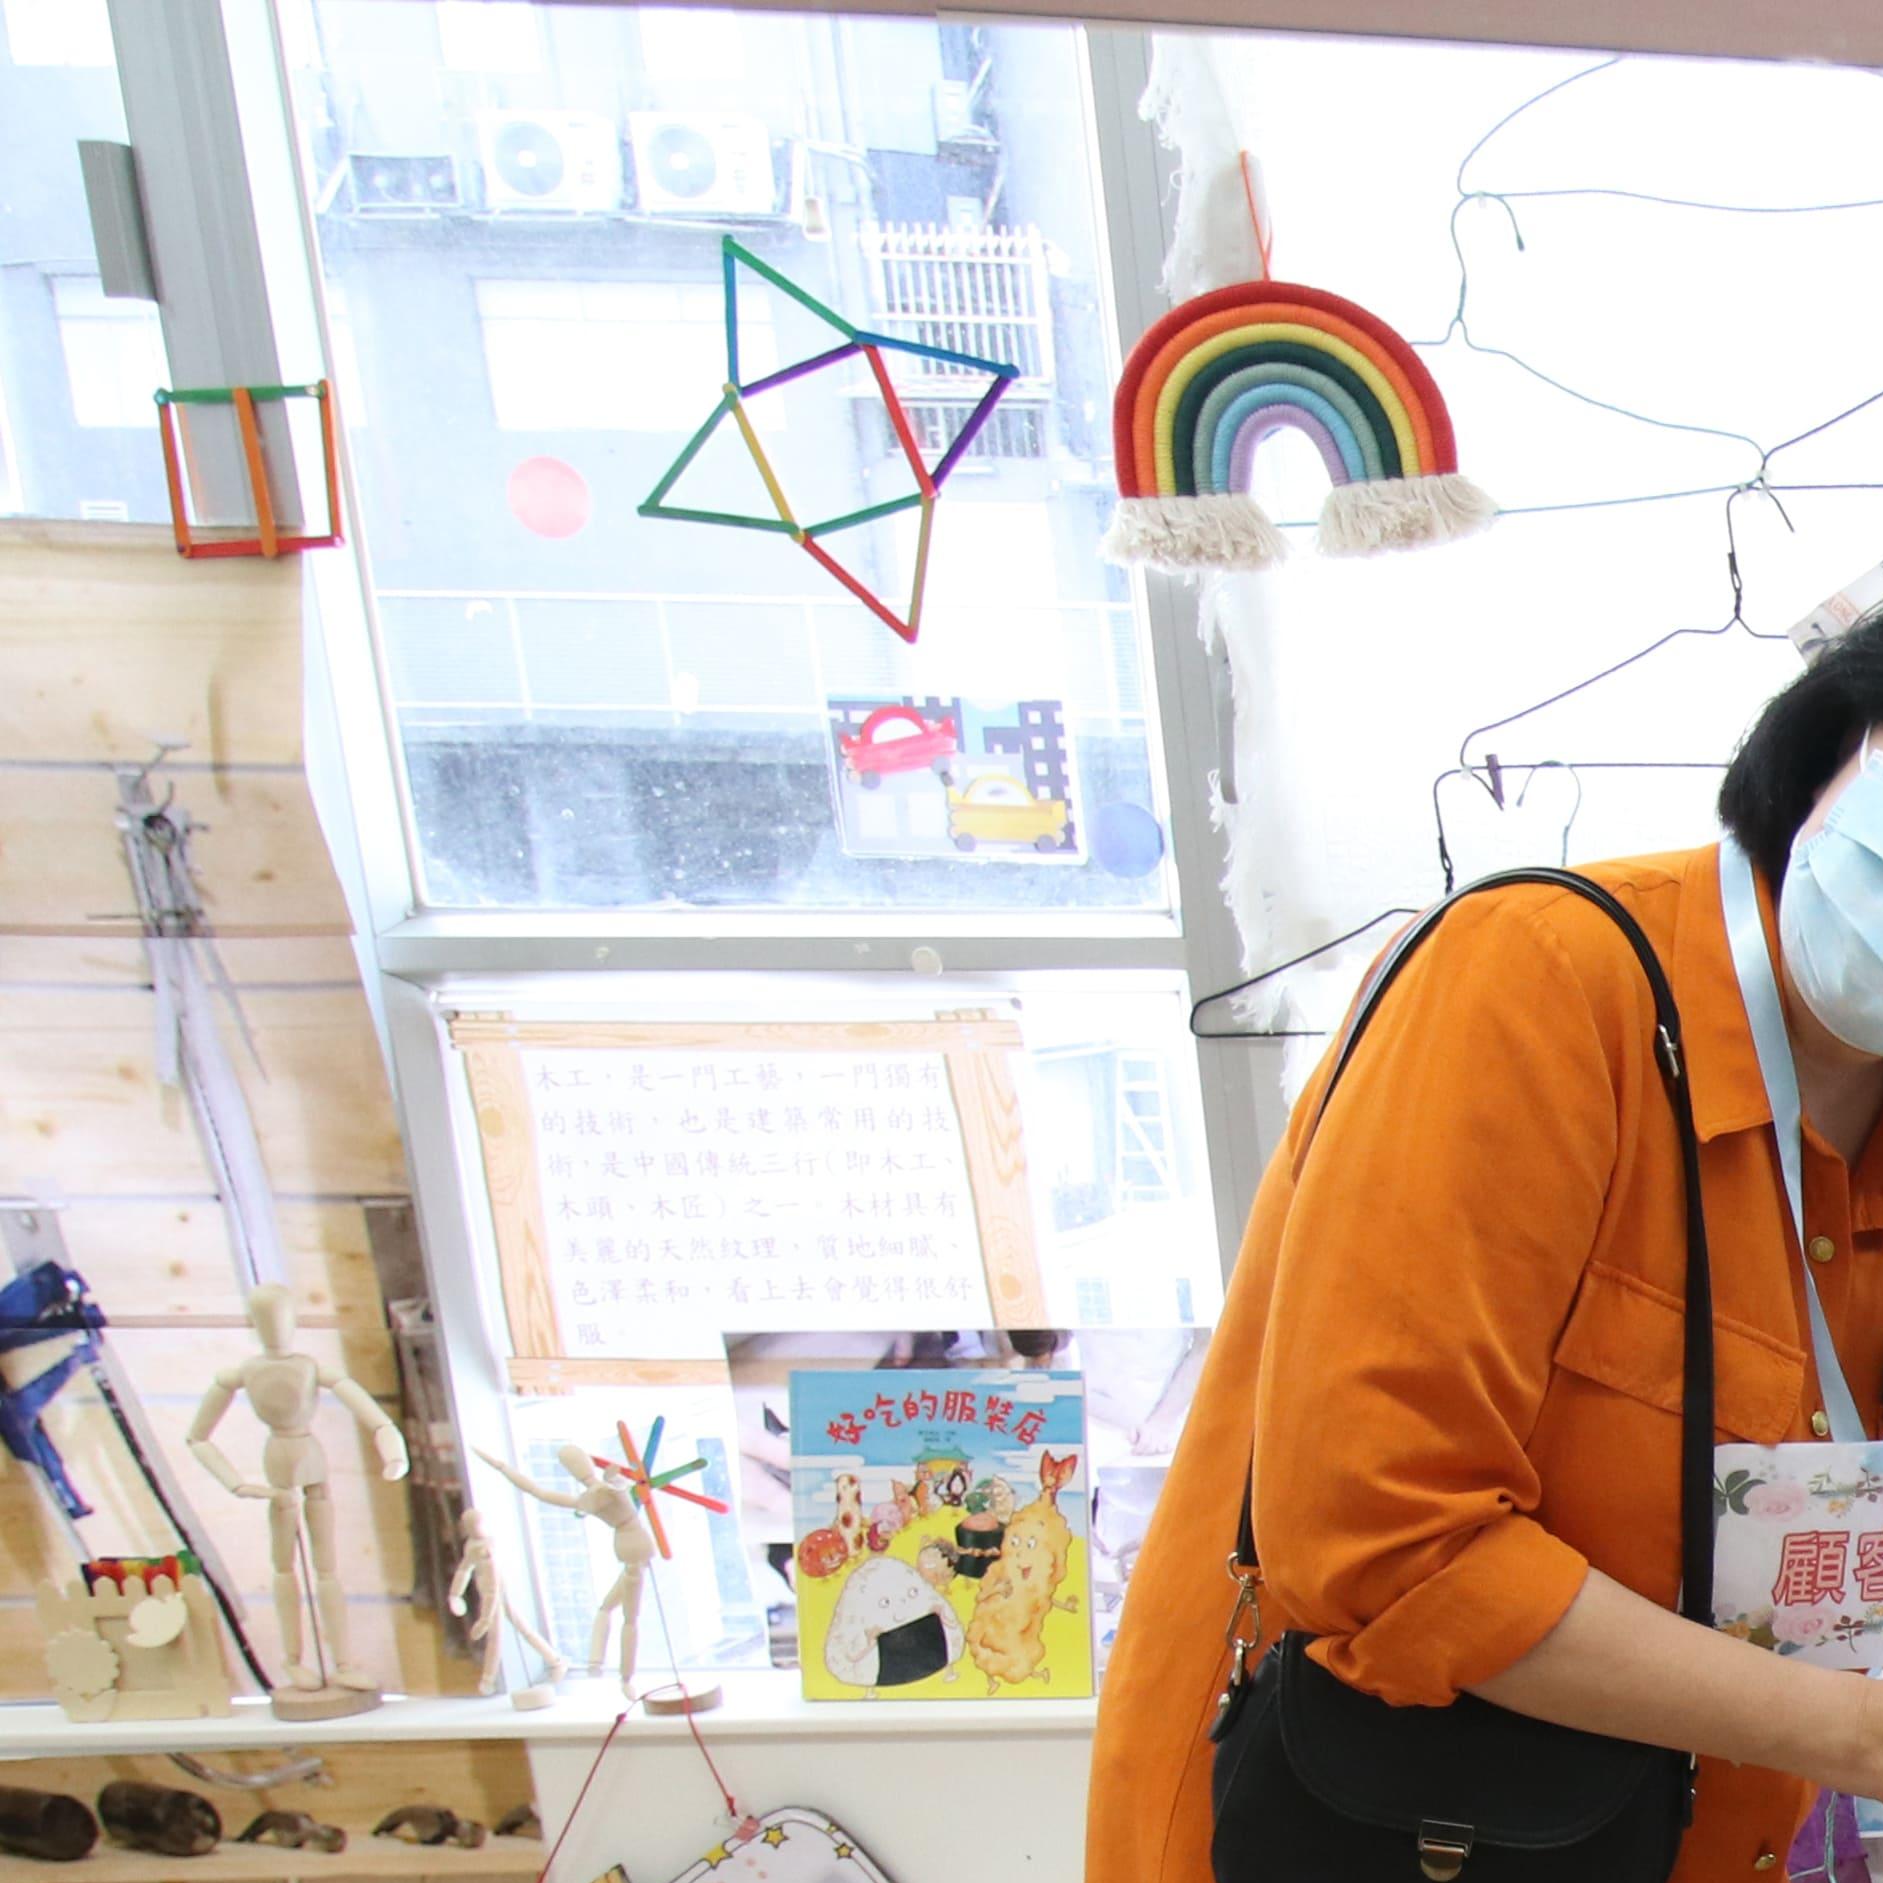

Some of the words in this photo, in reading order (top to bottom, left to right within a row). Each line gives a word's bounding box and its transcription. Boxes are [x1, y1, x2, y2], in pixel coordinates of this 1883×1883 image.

[826, 1389, 1048, 1446] 好吃的服裝店
